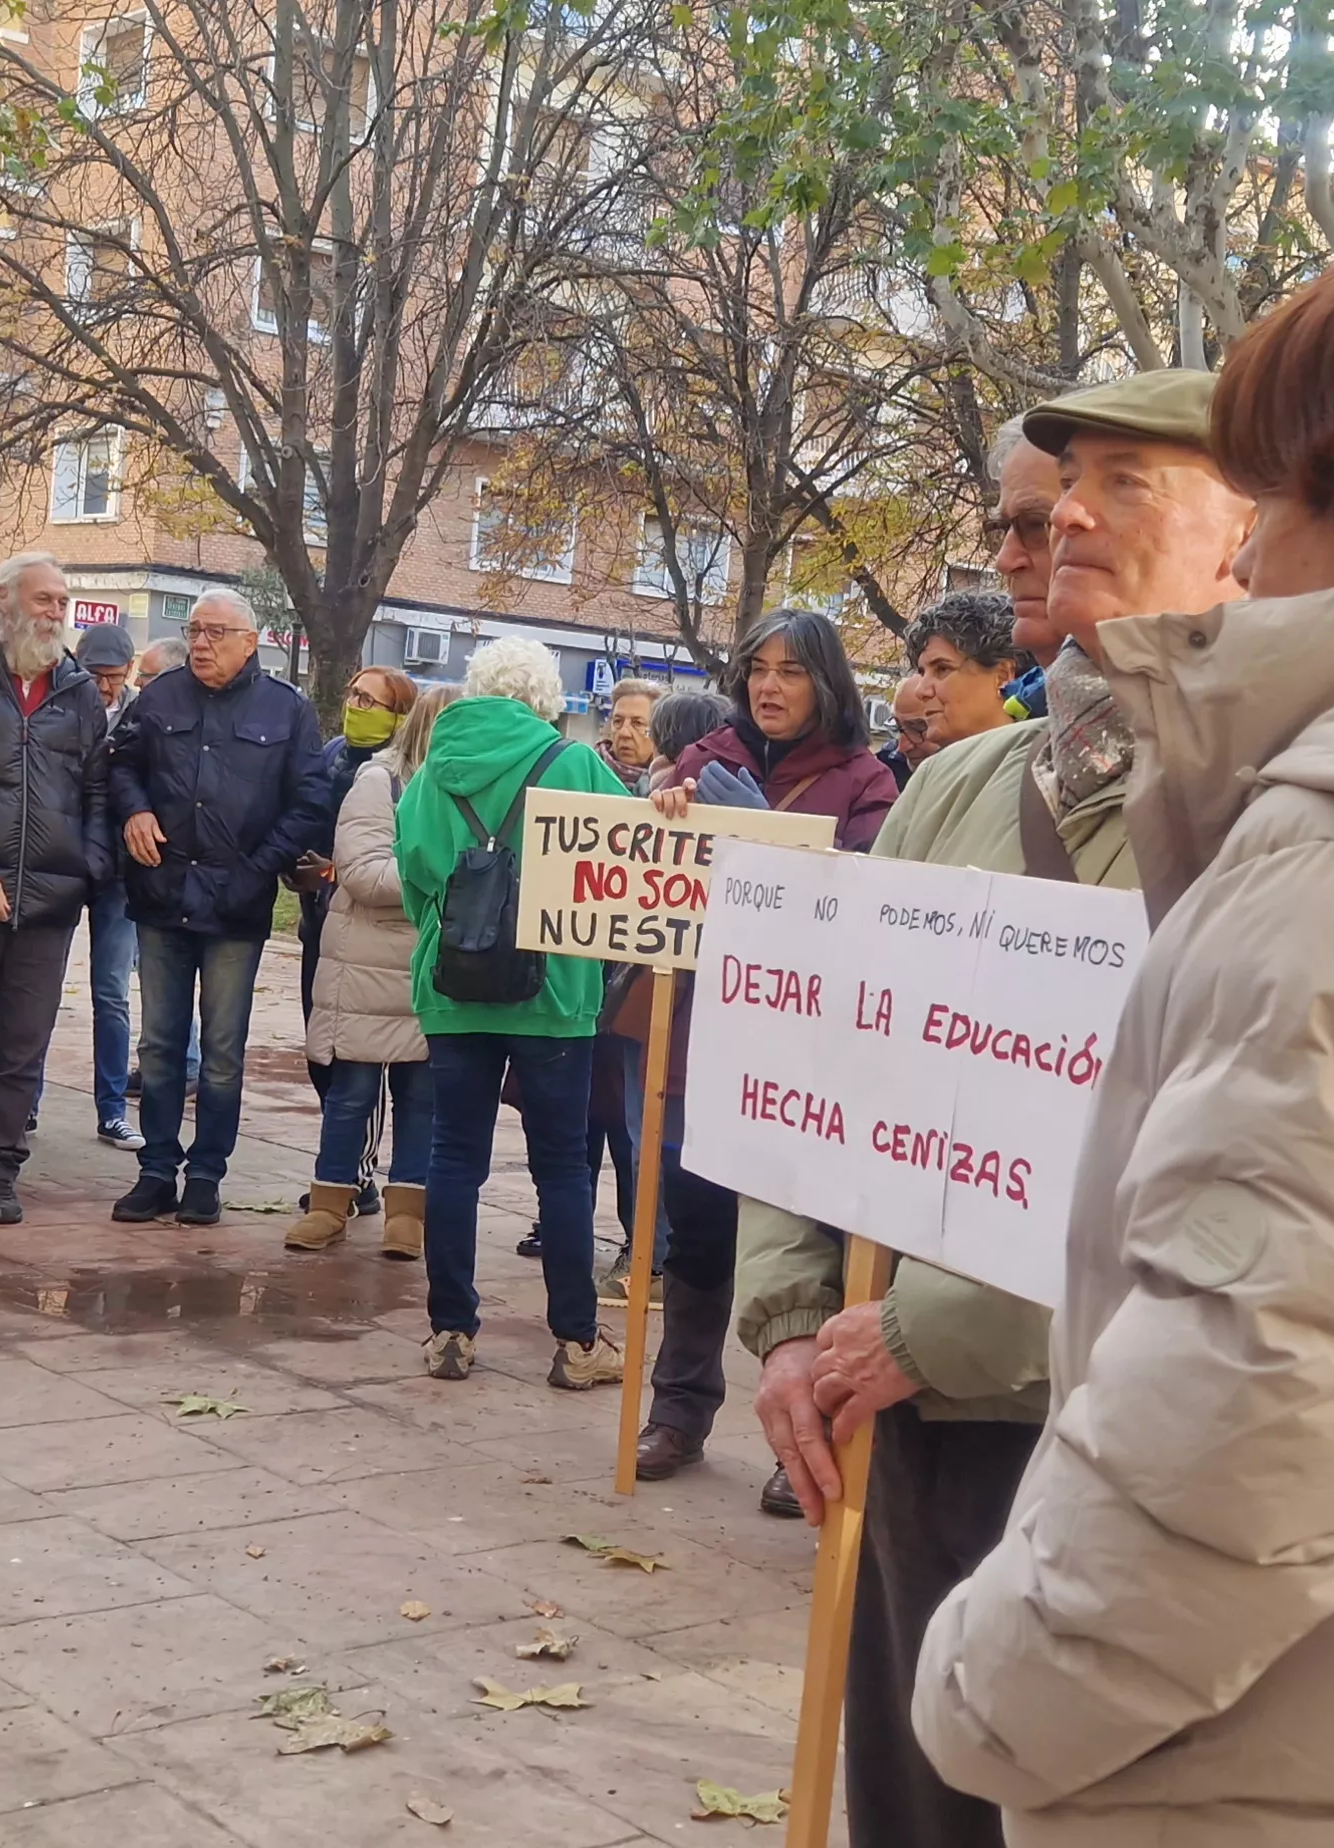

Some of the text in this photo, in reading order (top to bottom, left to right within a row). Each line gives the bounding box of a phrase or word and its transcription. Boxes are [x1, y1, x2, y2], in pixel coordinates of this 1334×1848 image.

[77, 603, 115, 622] ALFA
[534, 815, 715, 867] TUS CRITE
[573, 860, 710, 911] NO SON
[540, 908, 704, 959] NUEST
[724, 876, 785, 912] PORQUE
[814, 895, 839, 922] NO
[879, 903, 964, 937] PODEMOS,
[999, 924, 1126, 969] QUEREMOS
[721, 954, 822, 1018] DEJAR
[855, 980, 893, 1037] LA
[740, 1073, 845, 1145] HECHA
